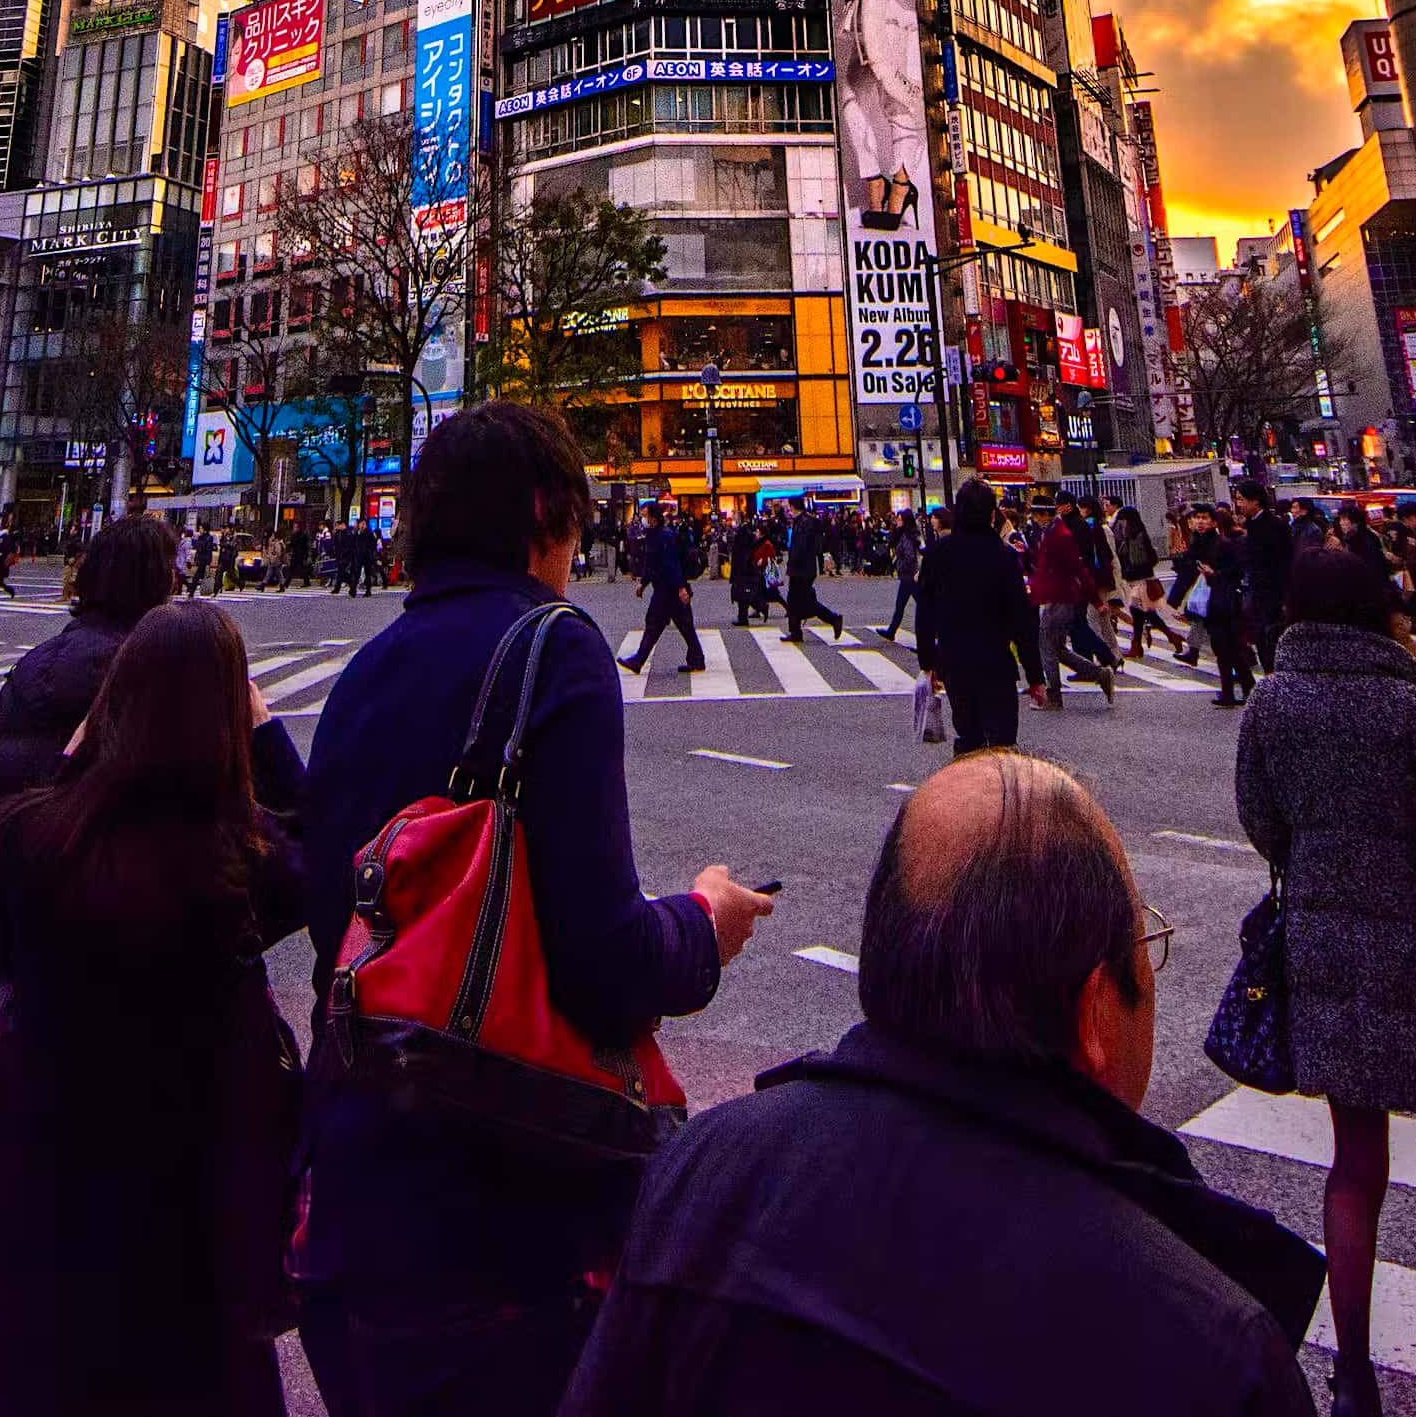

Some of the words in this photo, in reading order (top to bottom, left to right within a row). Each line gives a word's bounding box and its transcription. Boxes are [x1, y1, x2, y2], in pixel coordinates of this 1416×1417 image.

[243, 17, 320, 64] クリニック
[655, 62, 701, 77] AEON
[710, 61, 829, 77] 英会話イーオン
[499, 96, 530, 115] AEON
[535, 72, 620, 107] 英会話イーオン
[625, 66, 642, 80] 6F
[854, 240, 930, 271] KODA
[858, 307, 889, 324] New
[860, 327, 935, 368] 2.26
[1059, 341, 1081, 363] アコム
[863, 371, 887, 394] On
[892, 371, 936, 394] Sale
